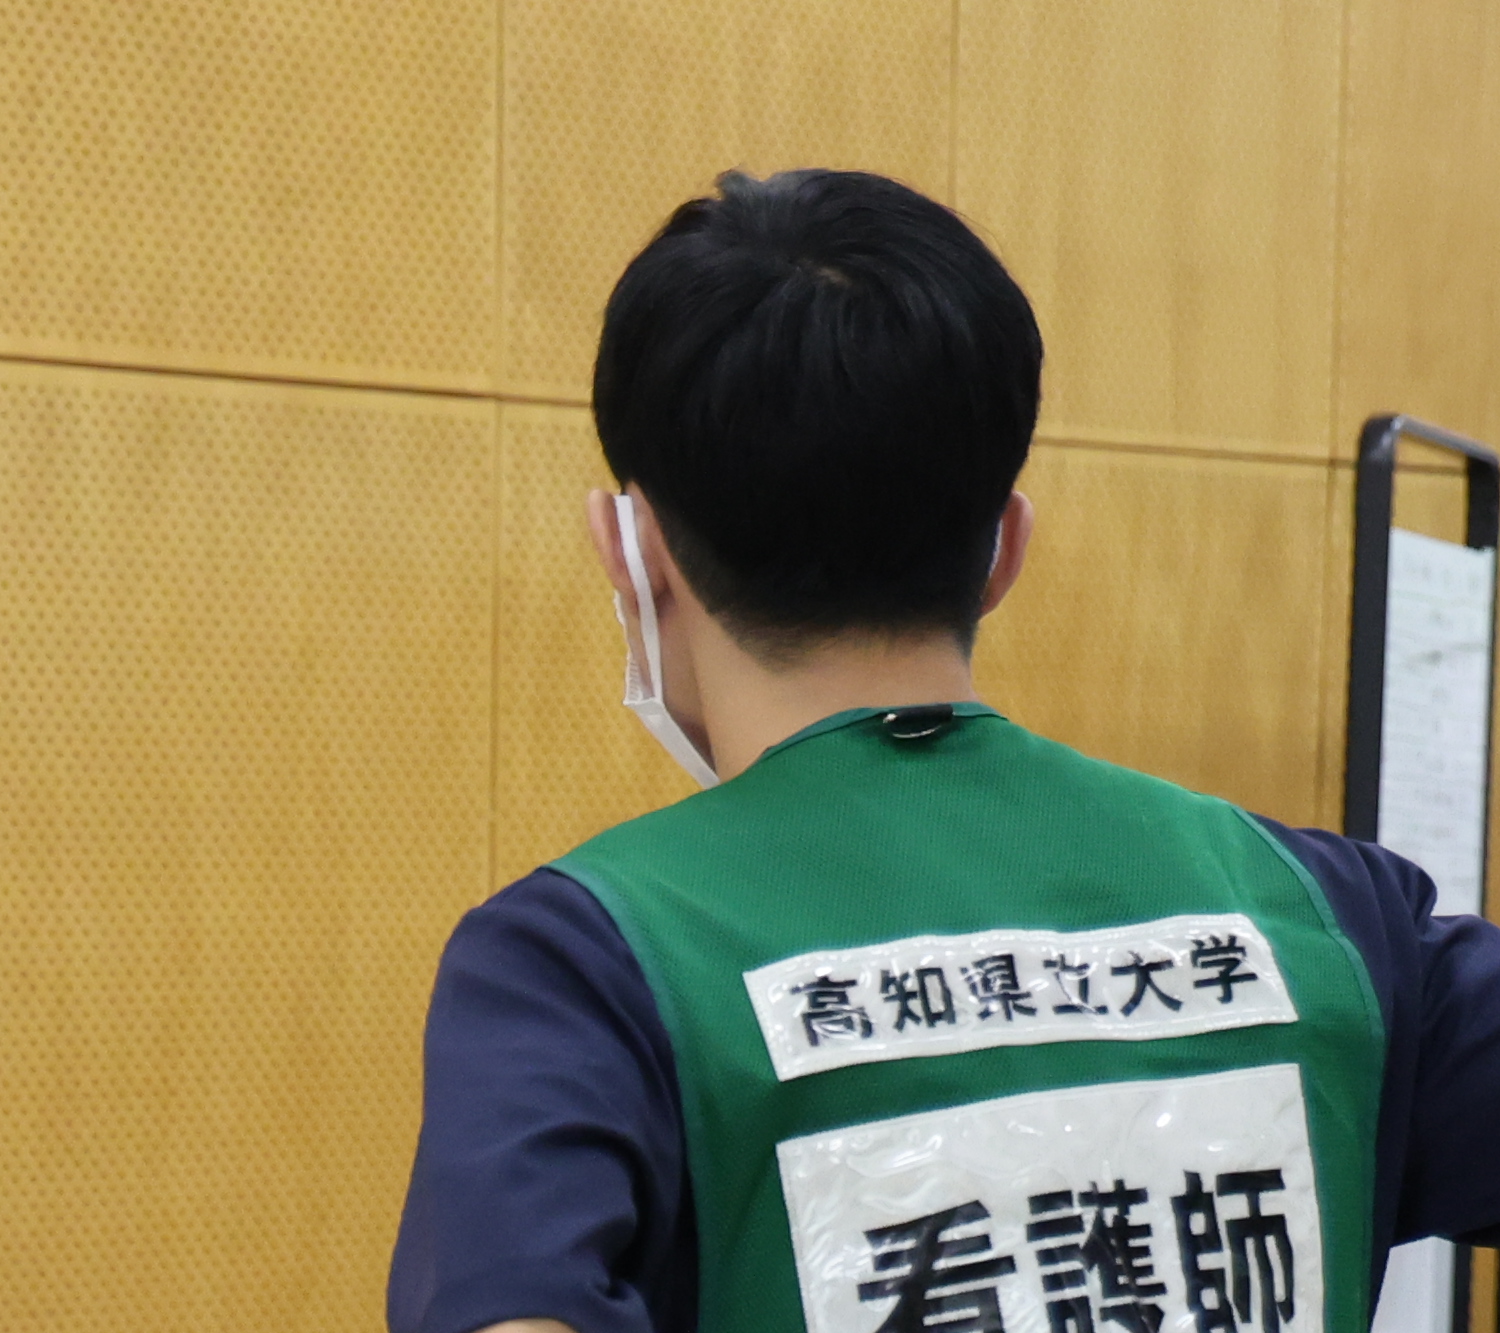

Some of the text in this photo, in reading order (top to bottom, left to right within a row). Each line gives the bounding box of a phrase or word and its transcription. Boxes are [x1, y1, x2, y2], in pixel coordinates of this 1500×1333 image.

[790, 933, 1259, 1047] 高知県立大学
